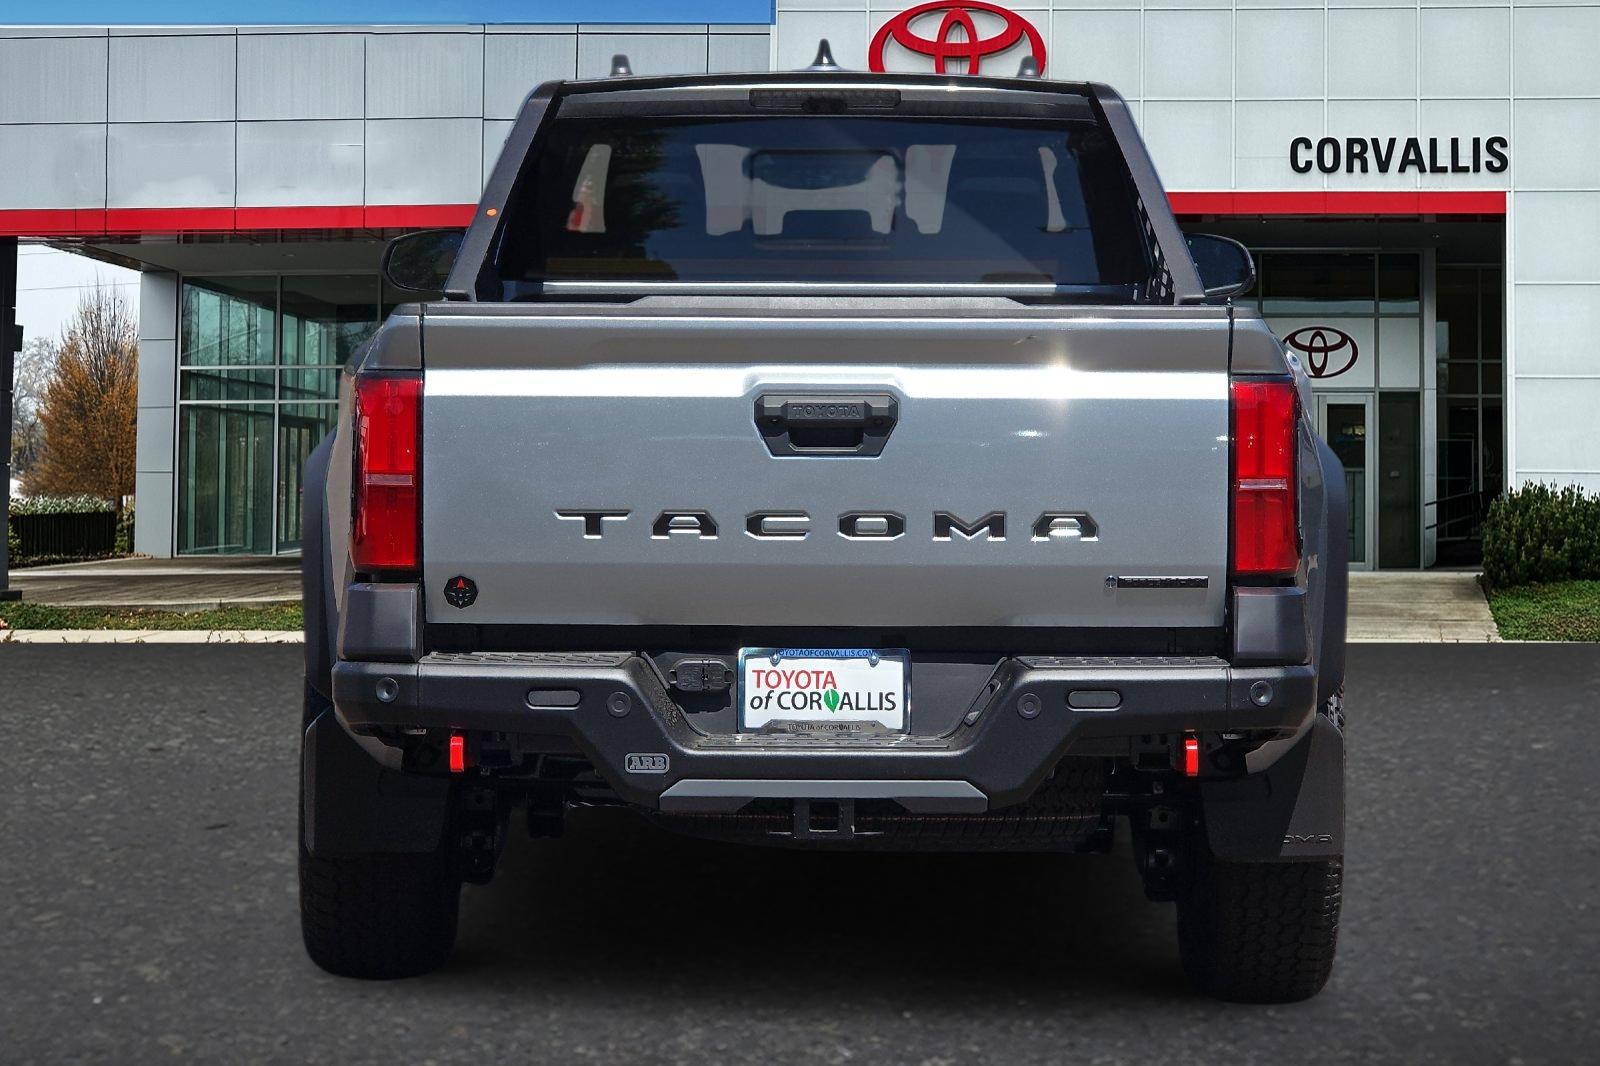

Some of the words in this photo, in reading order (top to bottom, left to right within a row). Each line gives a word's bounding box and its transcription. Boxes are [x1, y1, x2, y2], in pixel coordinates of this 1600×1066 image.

[1290, 136, 1509, 173] CORVALLIS
[792, 405, 860, 418] TOYOTA
[553, 509, 1100, 541] TACOMA
[776, 649, 876, 657] OYOTAOFCORVALLIS.COM
[752, 669, 837, 689] TOYOTA
[750, 690, 774, 710] of
[788, 723, 815, 731] TOYOTA
[629, 756, 666, 770] ARB
